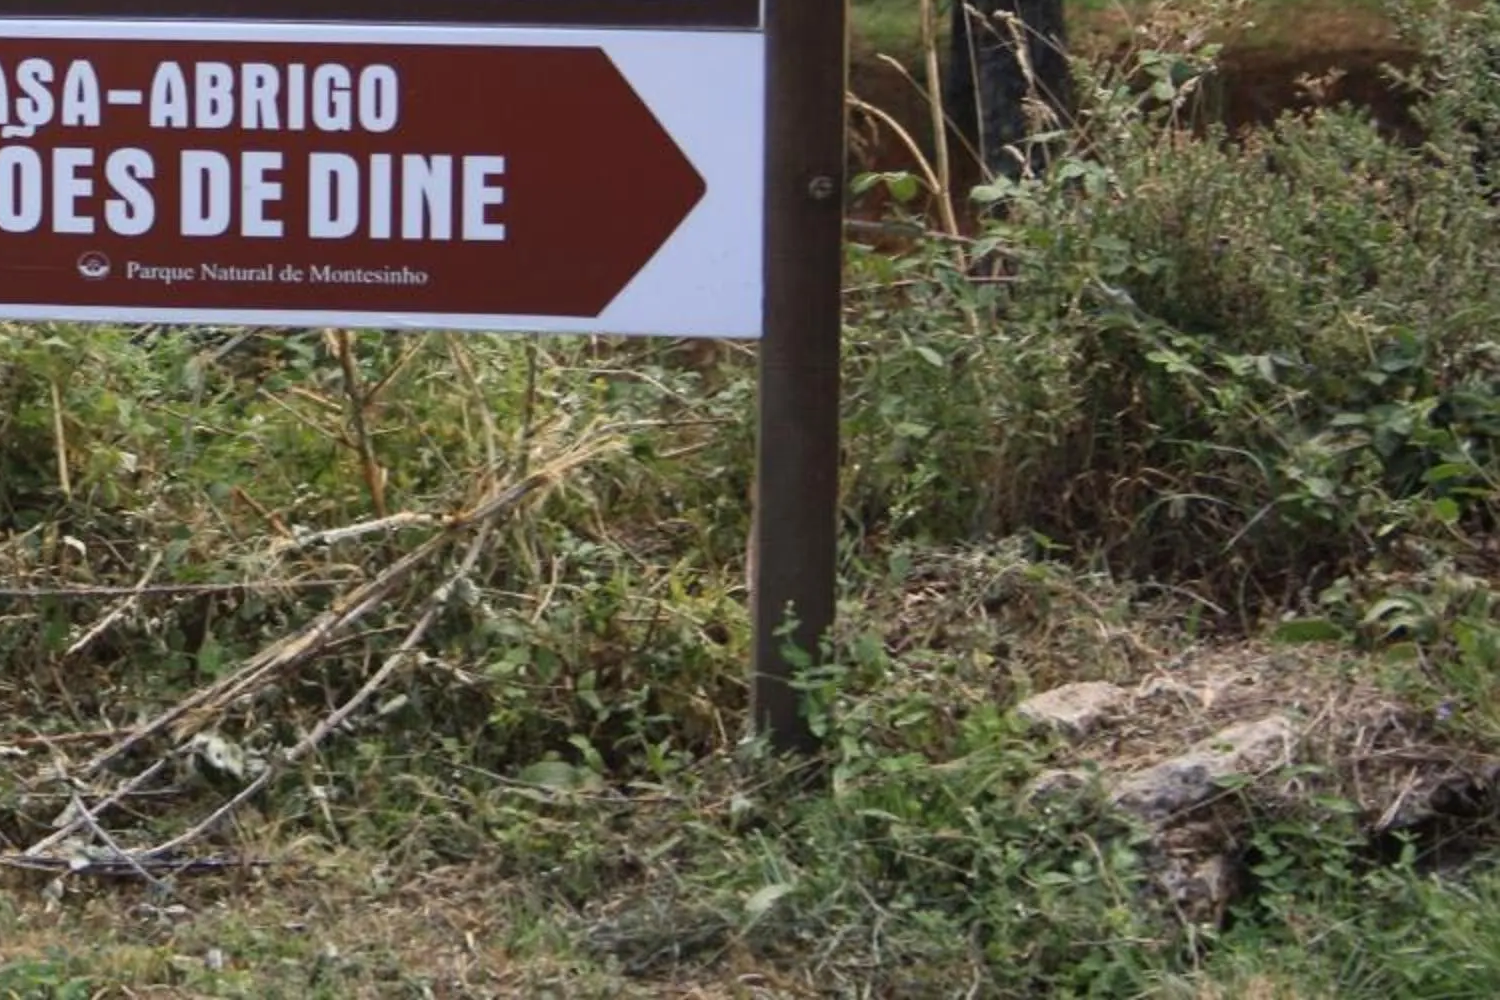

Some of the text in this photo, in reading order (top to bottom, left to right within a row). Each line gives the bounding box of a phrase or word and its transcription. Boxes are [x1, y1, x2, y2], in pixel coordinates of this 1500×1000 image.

[180, 149, 285, 237] DE
[308, 152, 506, 241] DINE
[125, 260, 430, 286] Parque Natural de Montesinho
